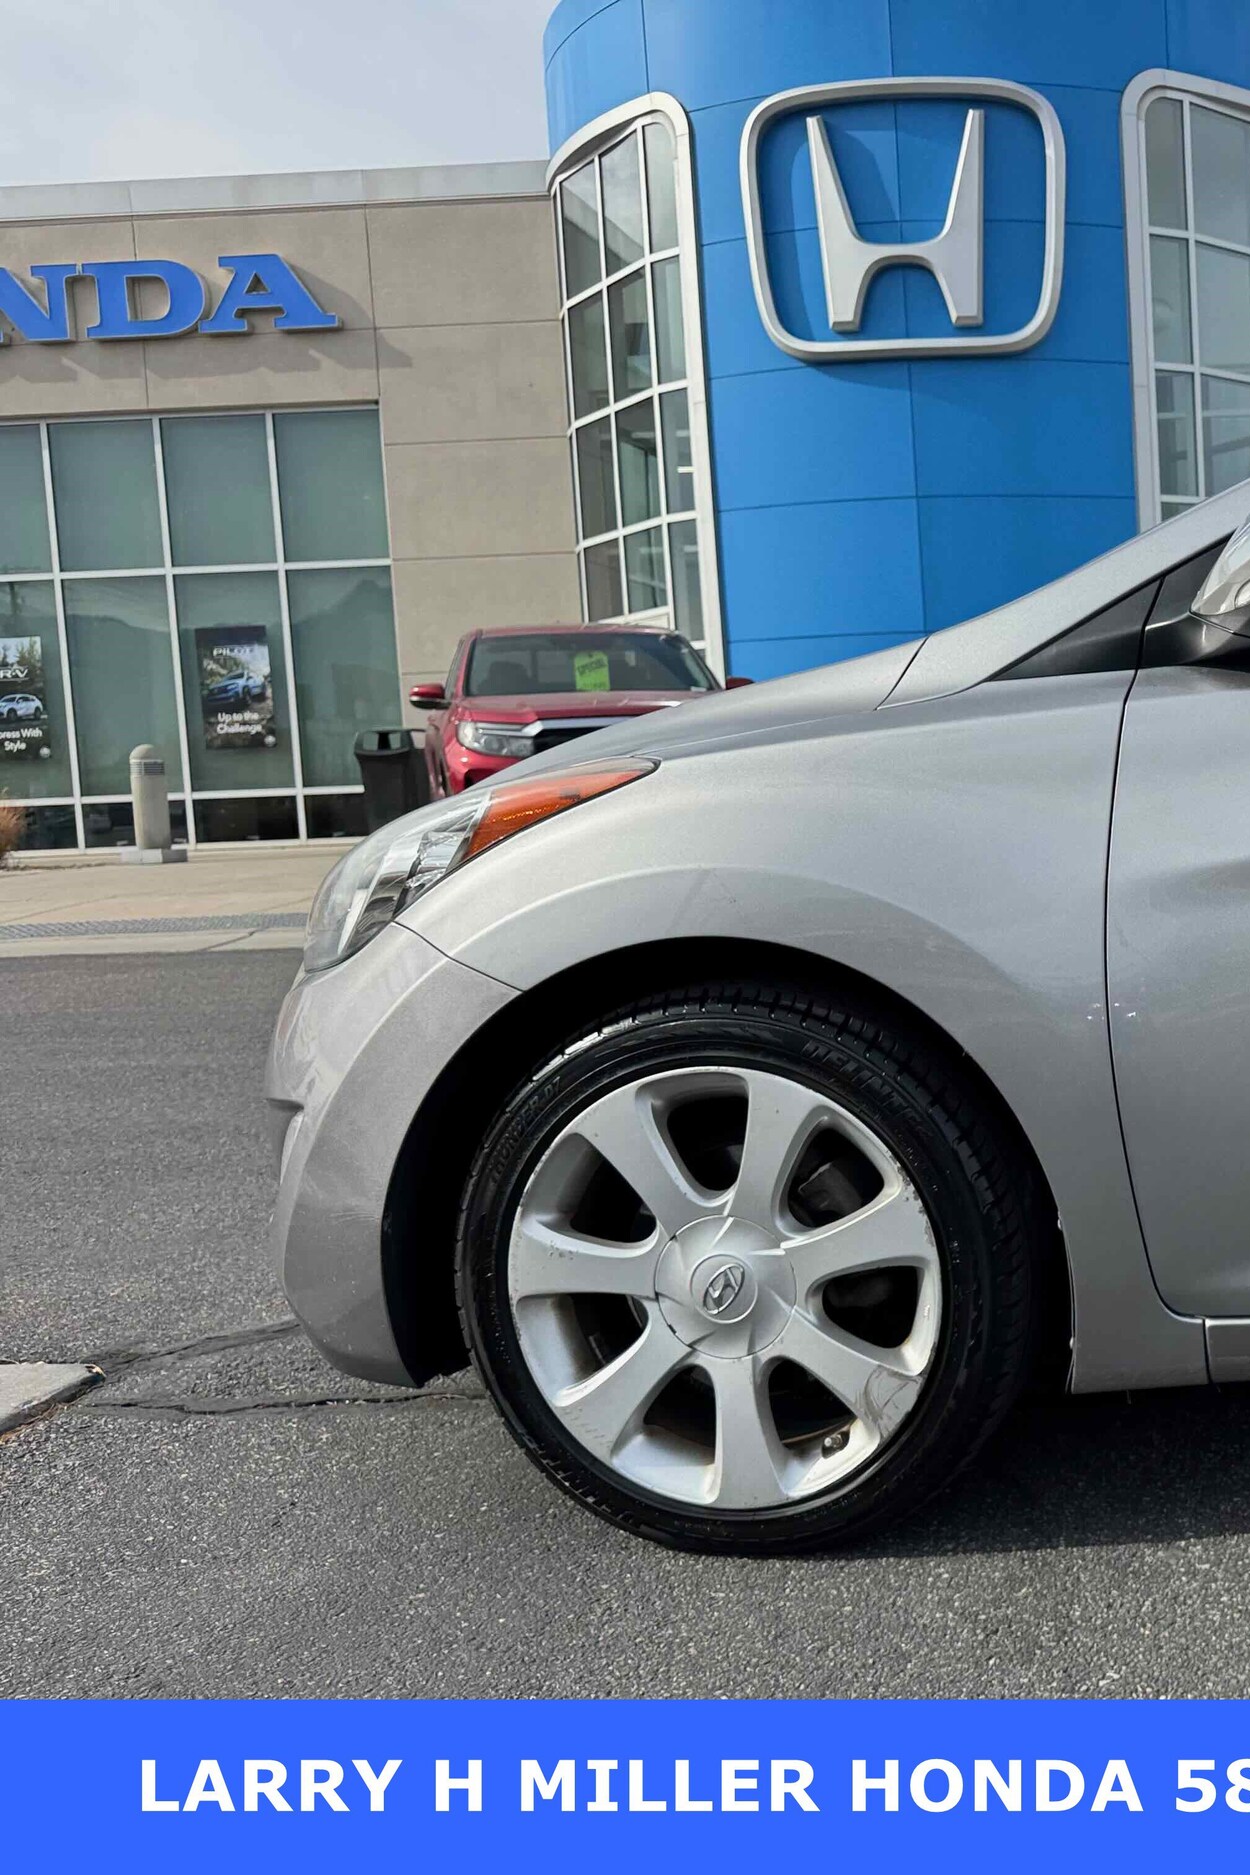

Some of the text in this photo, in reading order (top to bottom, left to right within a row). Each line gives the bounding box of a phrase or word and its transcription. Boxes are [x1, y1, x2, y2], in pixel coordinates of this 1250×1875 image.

[213, 647, 254, 657] PILOT
[218, 711, 260, 724] Up to the
[21, 727, 42, 738] With
[217, 722, 262, 735] Challenge
[4, 740, 27, 753] Style
